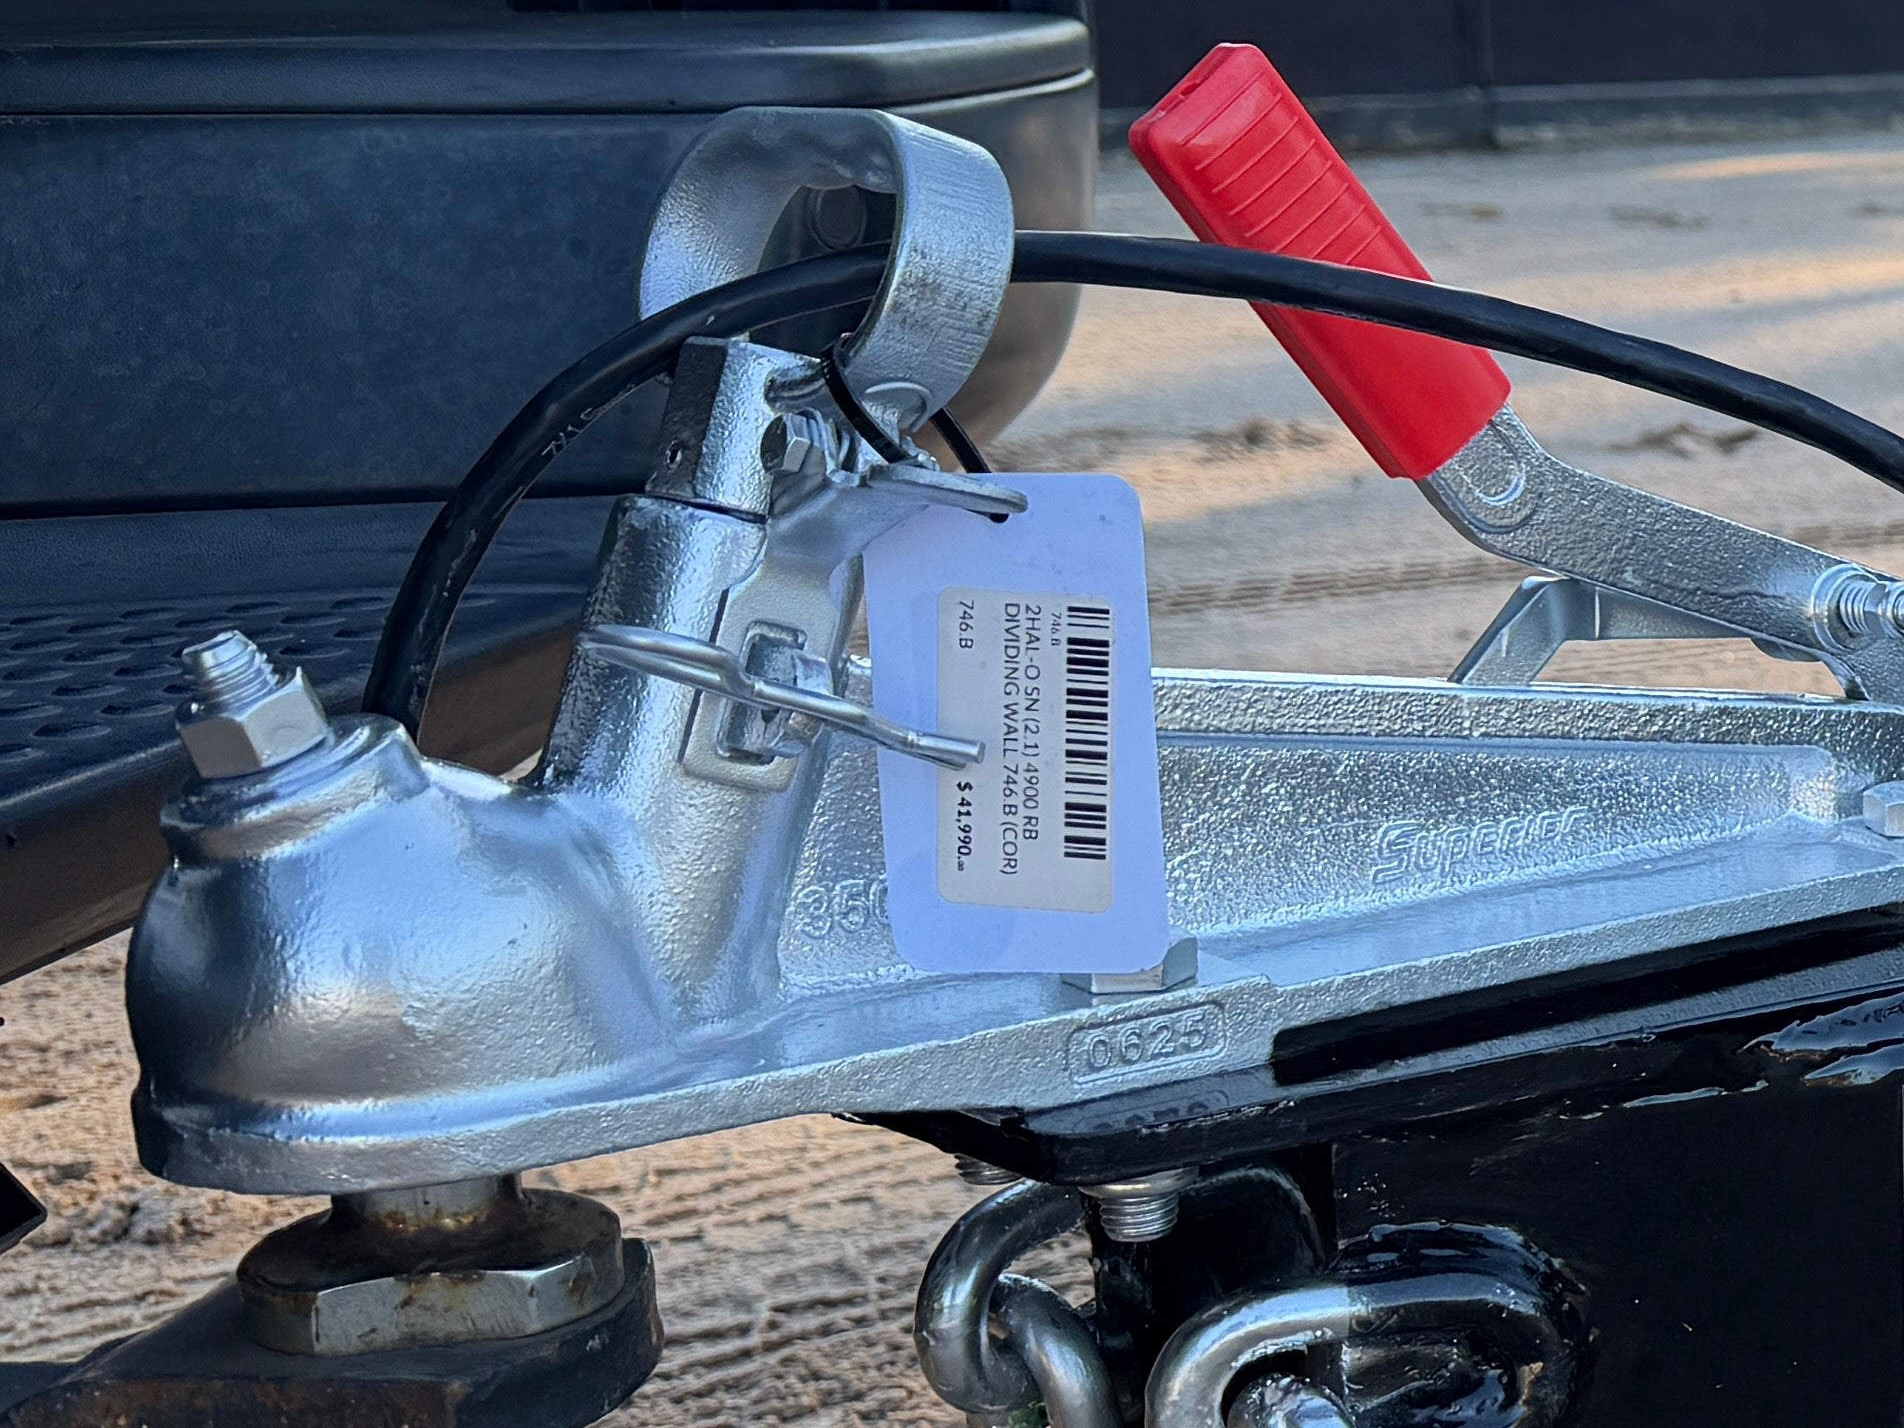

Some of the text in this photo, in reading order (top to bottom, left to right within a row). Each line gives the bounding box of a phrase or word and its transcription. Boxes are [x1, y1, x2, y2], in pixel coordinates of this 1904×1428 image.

[957, 599, 975, 649] 746.B
[1049, 611, 1062, 647] 746.B
[1023, 685, 1040, 712] SN
[999, 602, 1020, 875] DIVIDING WALL 746.B (COR)
[1021, 717, 1040, 758] (2.1)
[1022, 762, 1039, 809] 4900
[1022, 815, 1038, 841] RB
[1087, 1013, 1208, 1072] 0625
